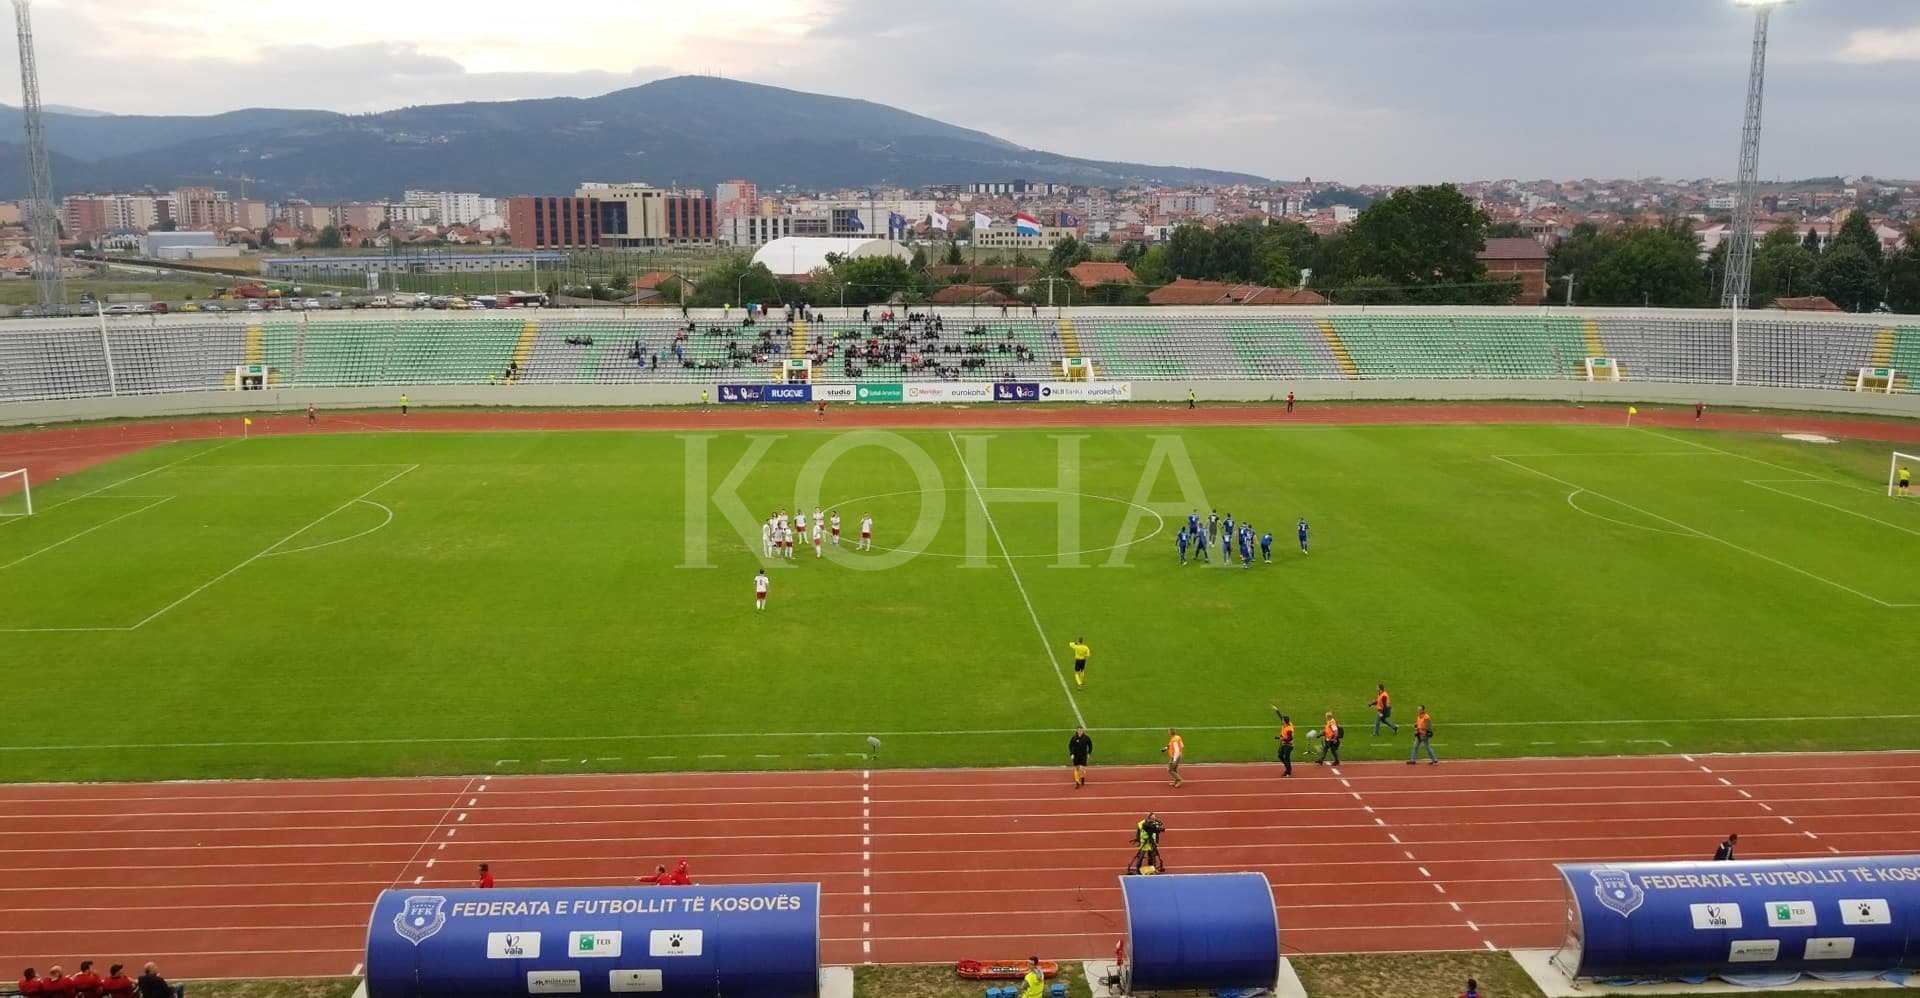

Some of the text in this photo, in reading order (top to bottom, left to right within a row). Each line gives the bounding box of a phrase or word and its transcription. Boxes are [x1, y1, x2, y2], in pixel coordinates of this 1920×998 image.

[951, 388, 986, 397] eurokoha
[1639, 874, 1733, 889] FEDERATA
[1735, 873, 1751, 886] E
[1750, 870, 1847, 886] FUTBOLLIT
[1847, 866, 1876, 882] TË
[451, 893, 801, 917] FEDERATA E FUTBOLLIT TË KOSOVËS
[410, 907, 432, 916] FFK
[1708, 916, 1727, 926] vala
[504, 945, 523, 955] vala
